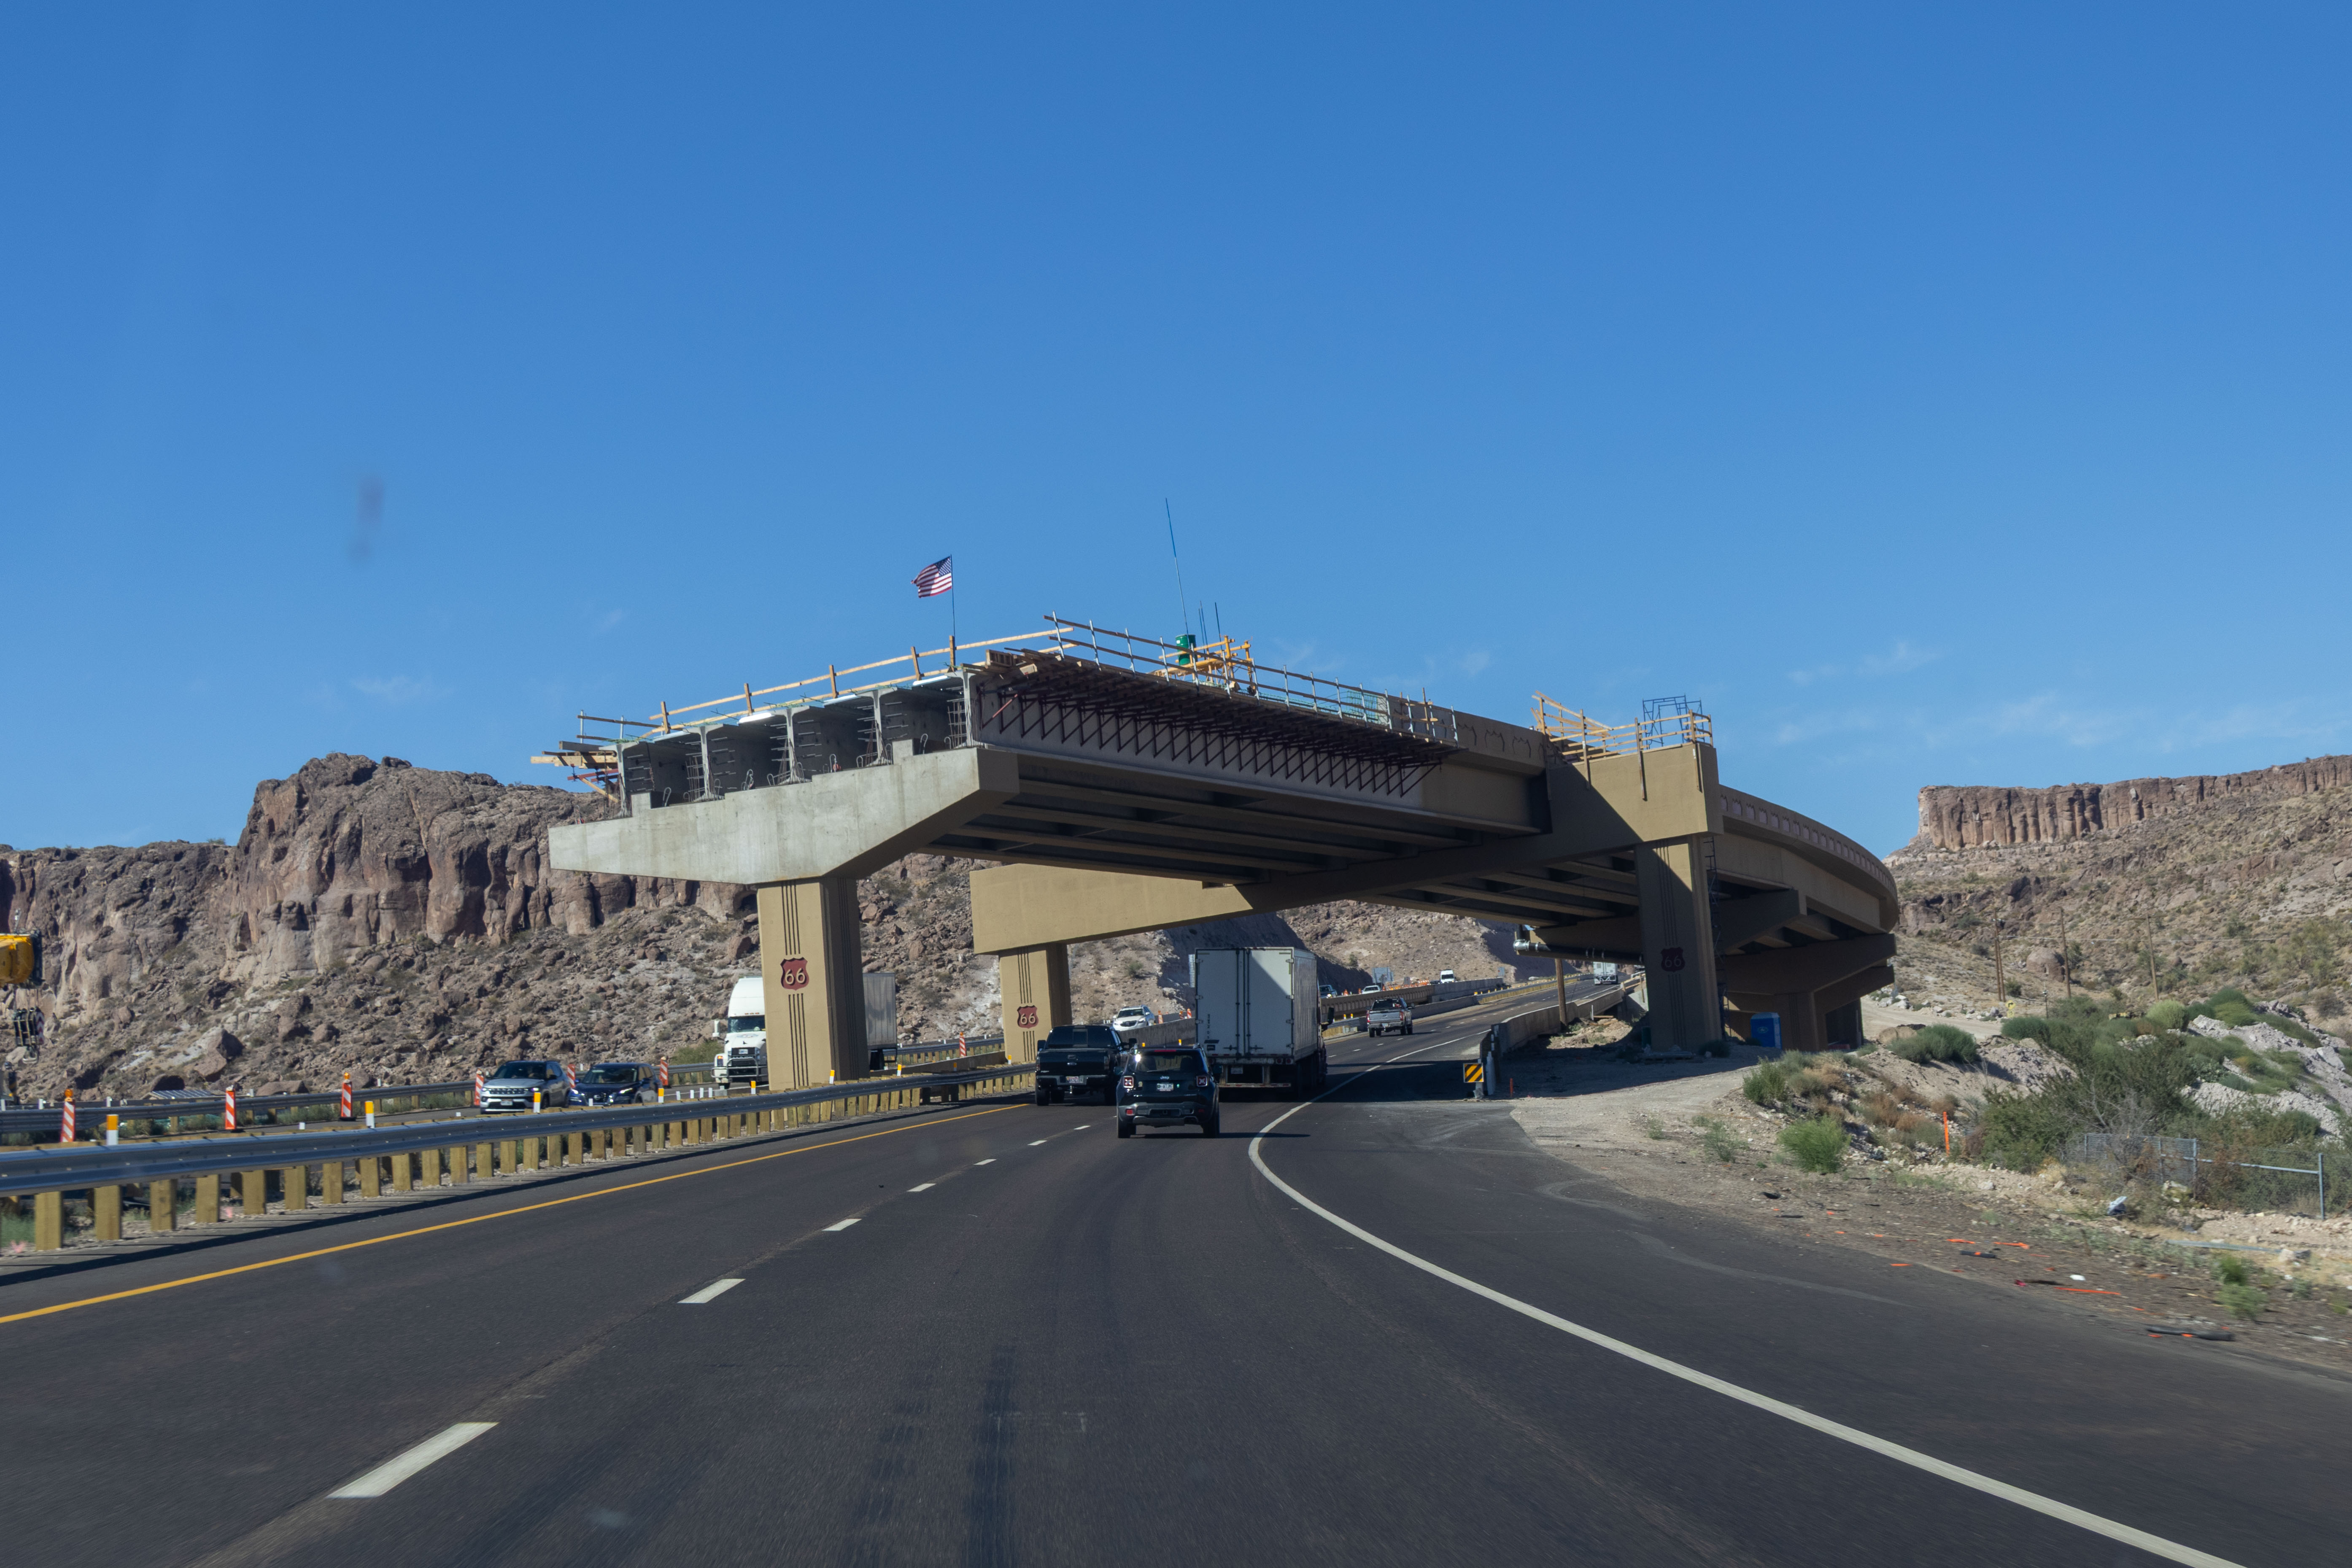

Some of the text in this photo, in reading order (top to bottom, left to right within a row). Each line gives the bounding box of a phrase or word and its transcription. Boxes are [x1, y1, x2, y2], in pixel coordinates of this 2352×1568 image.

[1665, 955, 1682, 968] 66
[785, 968, 806, 985] 66
[1020, 1012, 1036, 1024] 66
